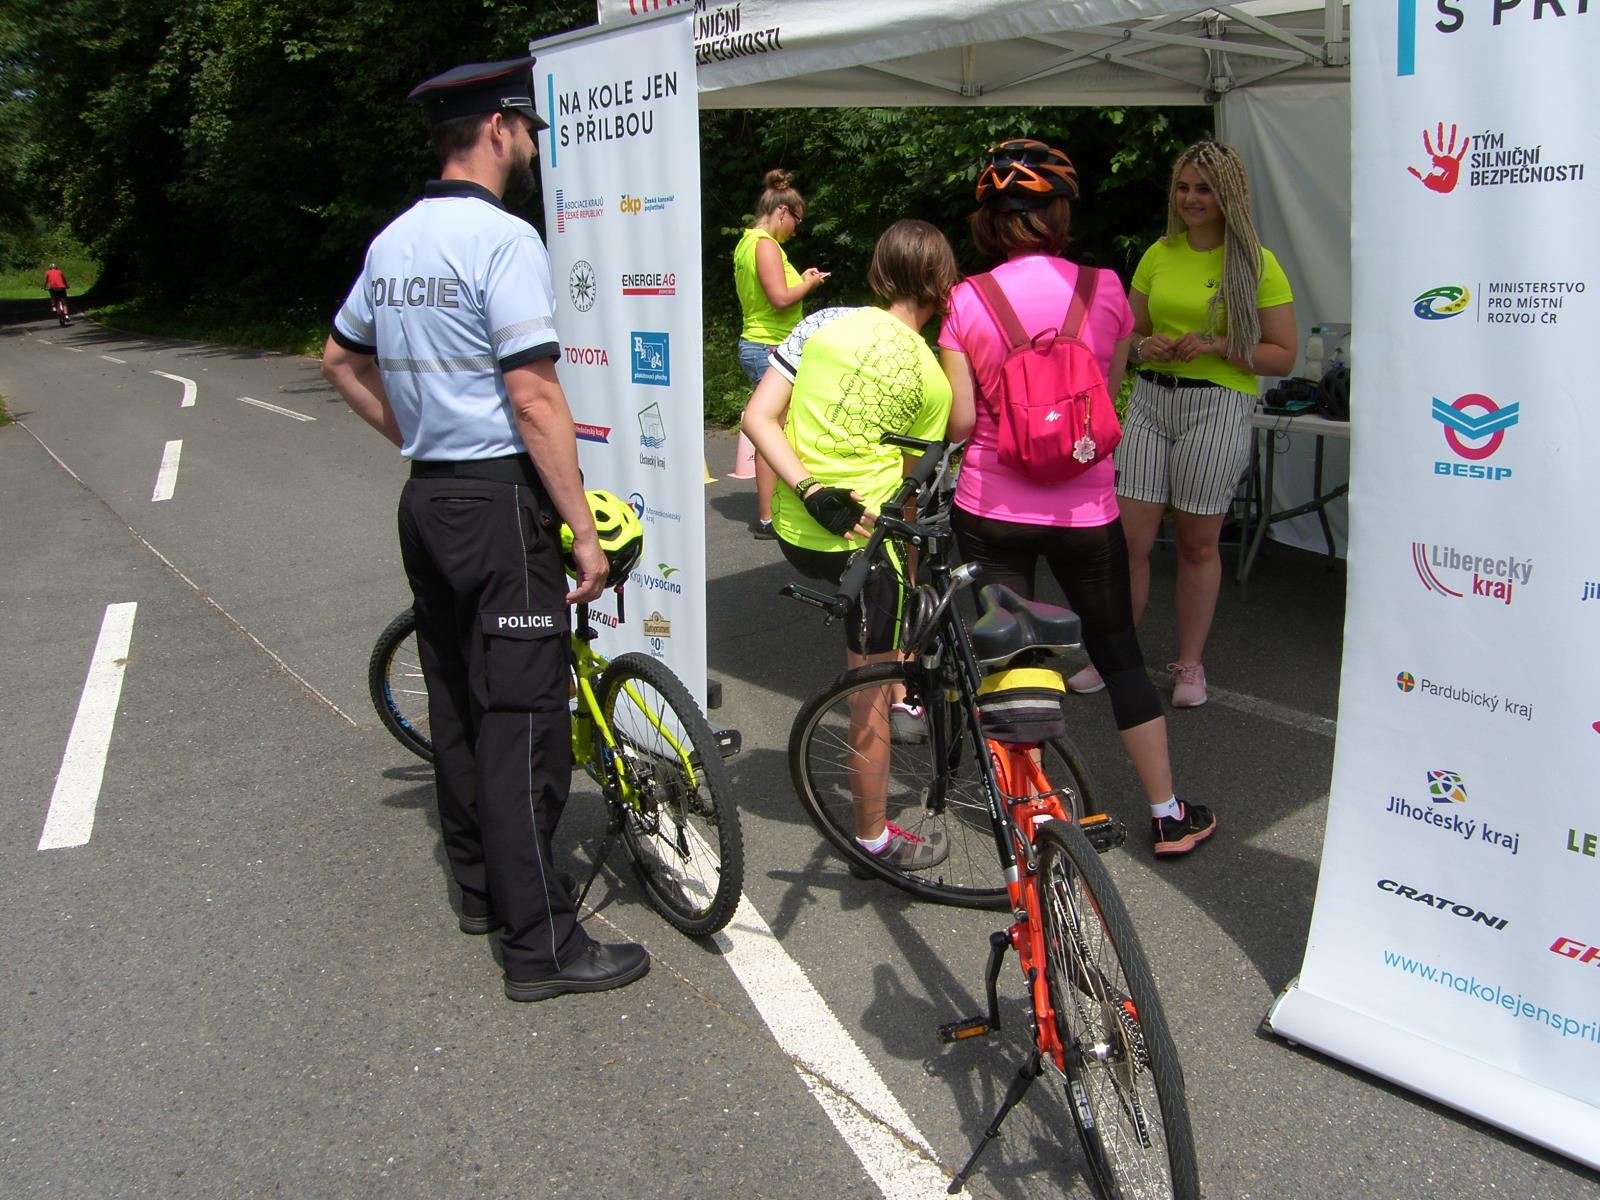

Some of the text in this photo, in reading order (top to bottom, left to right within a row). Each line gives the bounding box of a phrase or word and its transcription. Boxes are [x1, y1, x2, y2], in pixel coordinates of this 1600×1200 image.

[693, 3, 741, 41] LNIČNÍ
[694, 27, 783, 66] ZPEČNOSTI
[559, 71, 677, 116] NA KOLE JEN
[560, 110, 653, 147] S PŘILBOU
[1472, 130, 1504, 151] TÝM
[1471, 145, 1541, 169] SILNIČNÍ
[1470, 164, 1584, 187] BEZPEČNOSTI
[620, 194, 642, 215] čkp
[622, 273, 676, 287] ENERGIE AG
[1489, 282, 1586, 293] MINISTERSTVO
[1488, 295, 1564, 309] PRO MÍSTNÍ
[1487, 311, 1557, 324] ROZVOJ ČR
[564, 347, 609, 366] TOYOTA
[1434, 461, 1512, 481] BESIP
[1432, 545, 1533, 585] Liberecký
[1472, 573, 1513, 605] kraj
[498, 615, 554, 628] POLICIE
[1421, 679, 1533, 720] Pardubický kraj
[1386, 796, 1520, 855] Jihočeský kraj
[1377, 879, 1509, 931] CRATONI
